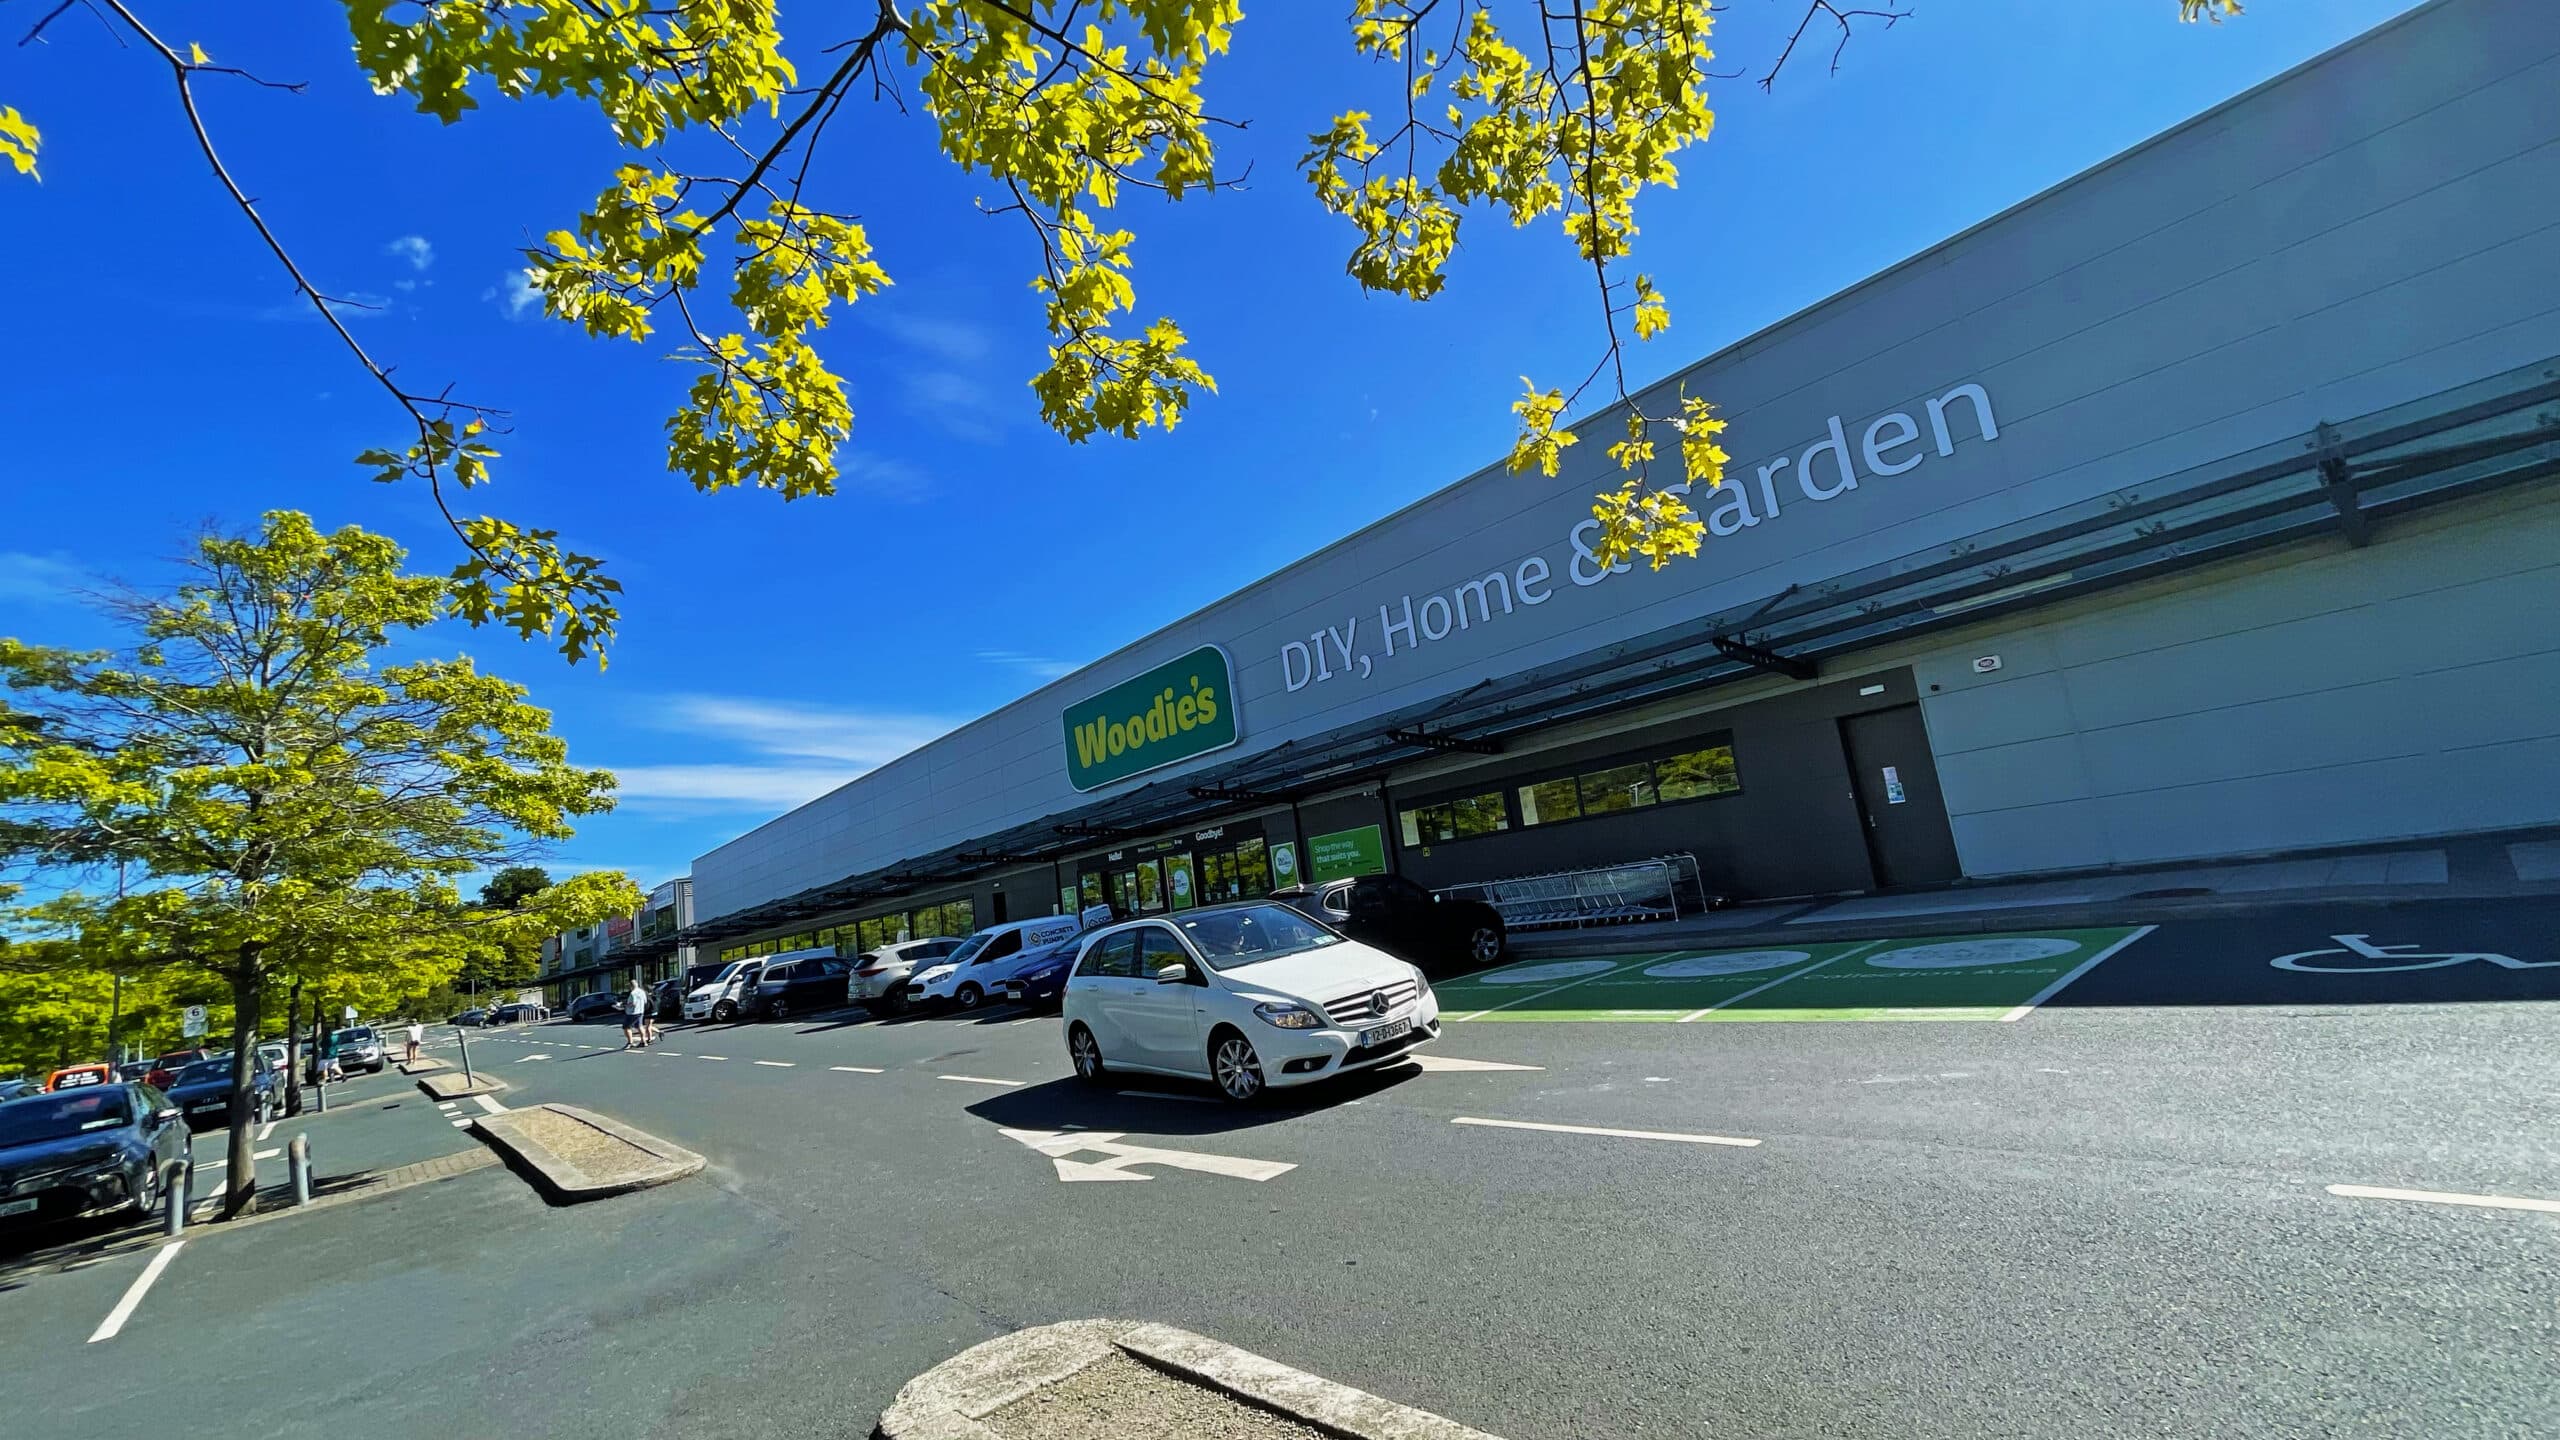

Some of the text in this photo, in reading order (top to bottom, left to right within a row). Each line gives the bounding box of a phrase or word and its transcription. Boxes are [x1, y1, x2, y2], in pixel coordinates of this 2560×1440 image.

[1281, 383, 1999, 693] DIY, Home & arden
[1074, 675, 1217, 769] Woodie's
[1195, 826, 1224, 842] Goodbye!
[1041, 926, 1074, 937] CONCRETE
